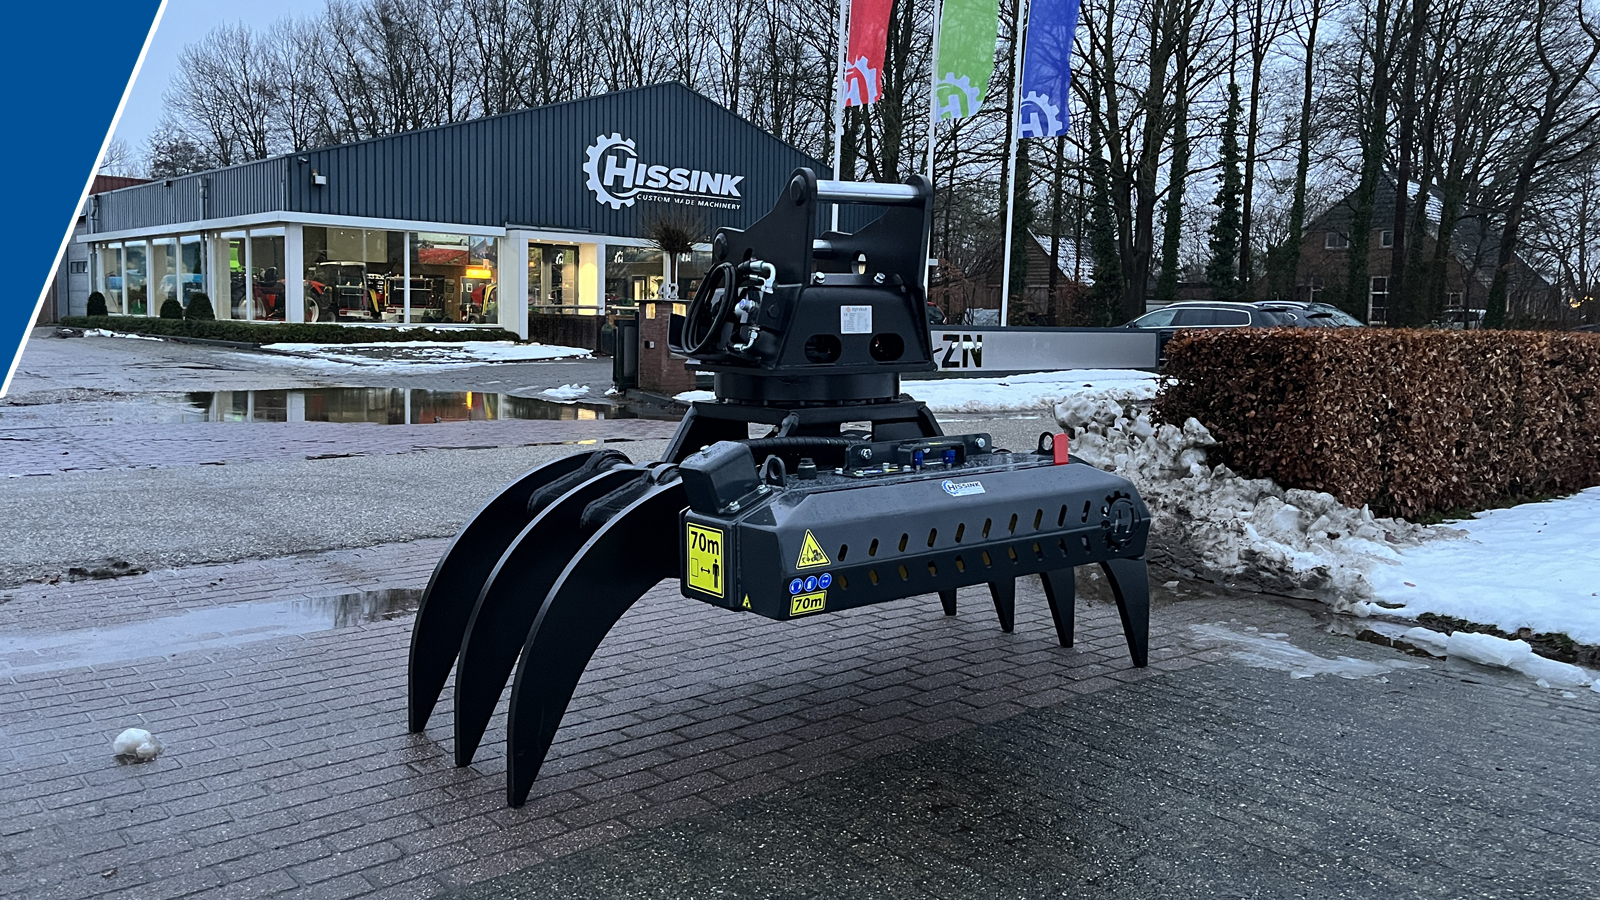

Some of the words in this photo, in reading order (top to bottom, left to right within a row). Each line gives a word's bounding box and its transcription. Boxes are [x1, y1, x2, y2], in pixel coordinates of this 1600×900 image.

[603, 155, 744, 197] HISSINK
[636, 193, 671, 204] CUSTOM
[674, 197, 695, 206] MADE
[697, 200, 741, 210] MACHINERY
[690, 530, 720, 556] 70m
[794, 597, 822, 611] 70m
